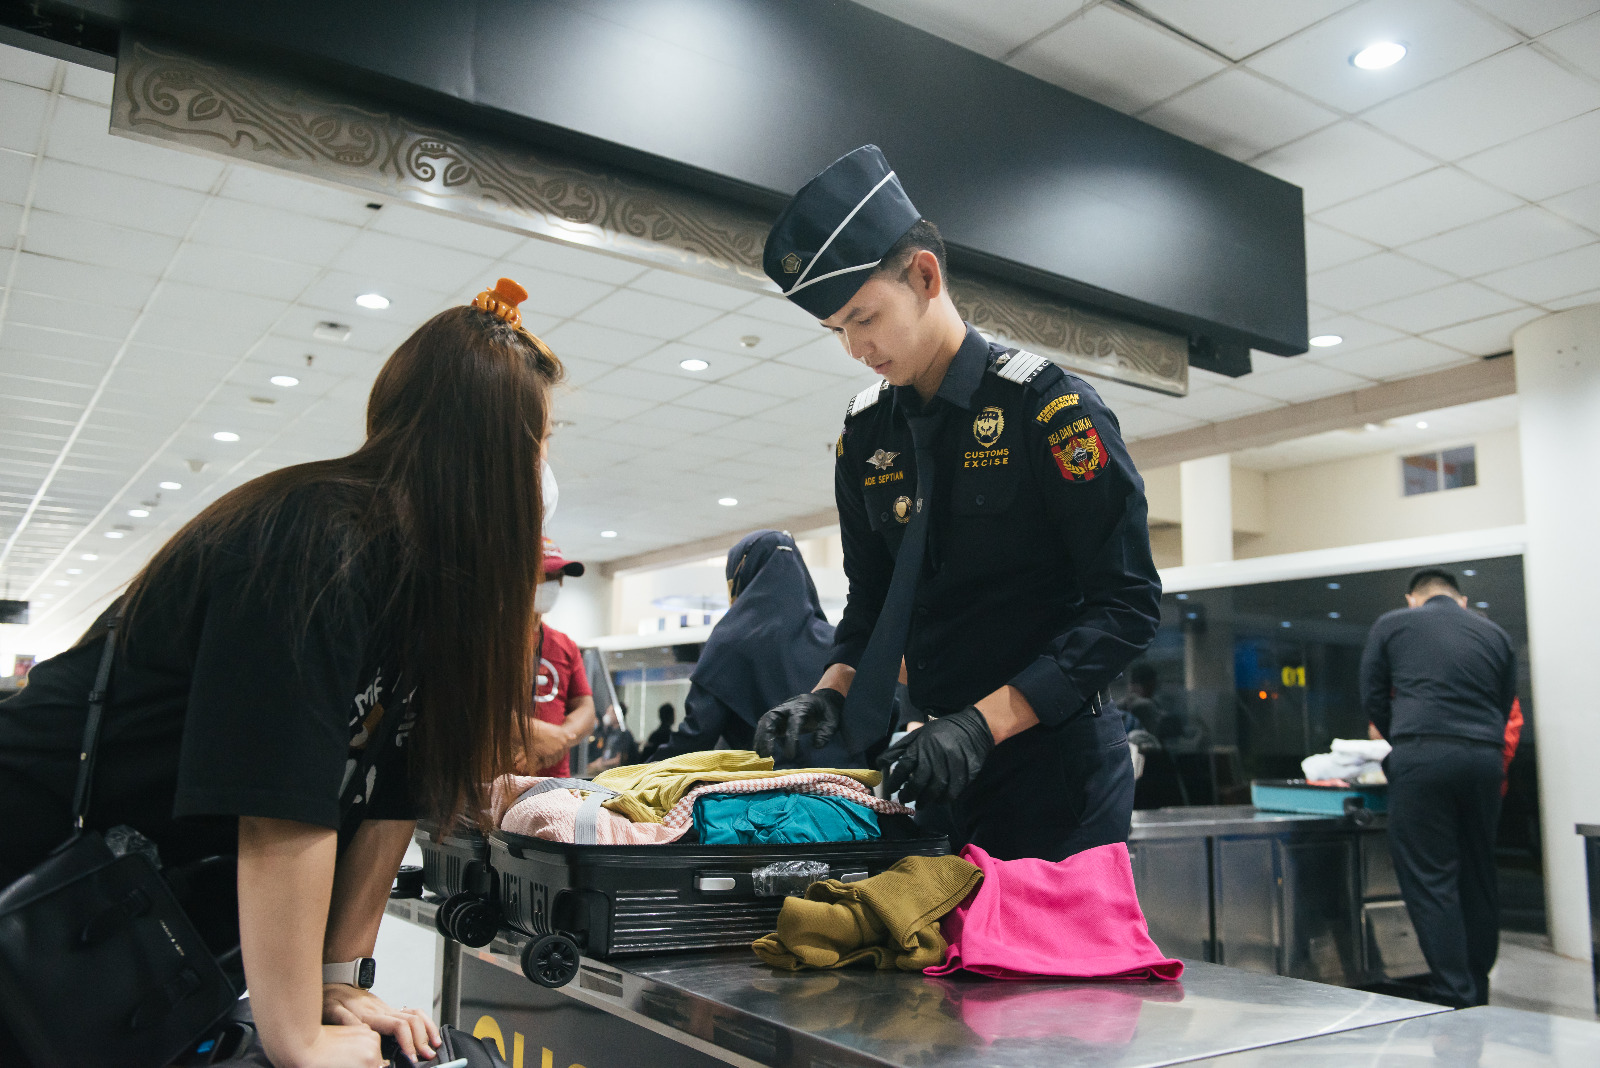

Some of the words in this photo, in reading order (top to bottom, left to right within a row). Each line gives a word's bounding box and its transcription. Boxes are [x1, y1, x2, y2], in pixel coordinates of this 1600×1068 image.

[1036, 393, 1080, 422] KEMENTERIAN
[1043, 399, 1079, 424] KEUANGAN
[1048, 431, 1061, 446] BEA
[1060, 424, 1074, 440] DAN
[1072, 416, 1093, 433] CUKAI
[964, 448, 1010, 459] CUSTOMS
[964, 457, 1009, 468] EXCISE
[864, 476, 876, 487] ADE
[878, 470, 904, 484] SEPTIAN
